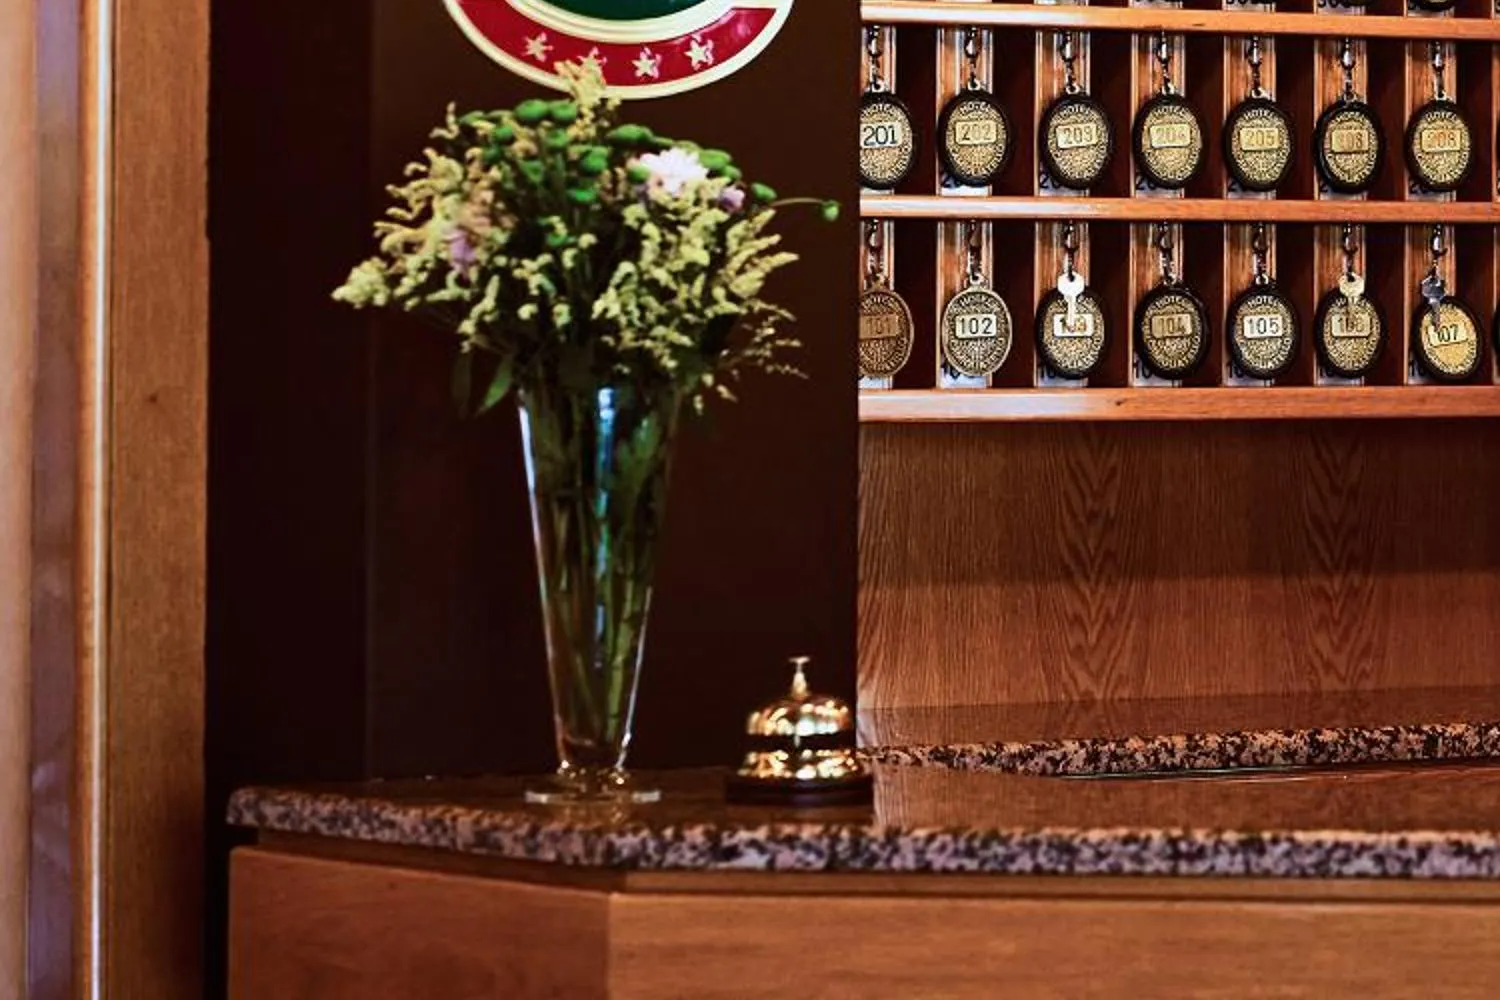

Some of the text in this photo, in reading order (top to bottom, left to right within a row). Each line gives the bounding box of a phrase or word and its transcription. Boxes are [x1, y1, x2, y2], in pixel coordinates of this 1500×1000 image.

[863, 125, 897, 146] 201
[961, 124, 992, 141] 202
[1063, 126, 1093, 144] 203
[1245, 130, 1275, 146] 205
[868, 319, 892, 335] 101
[960, 318, 993, 334] 102
[1248, 317, 1279, 335] 105
